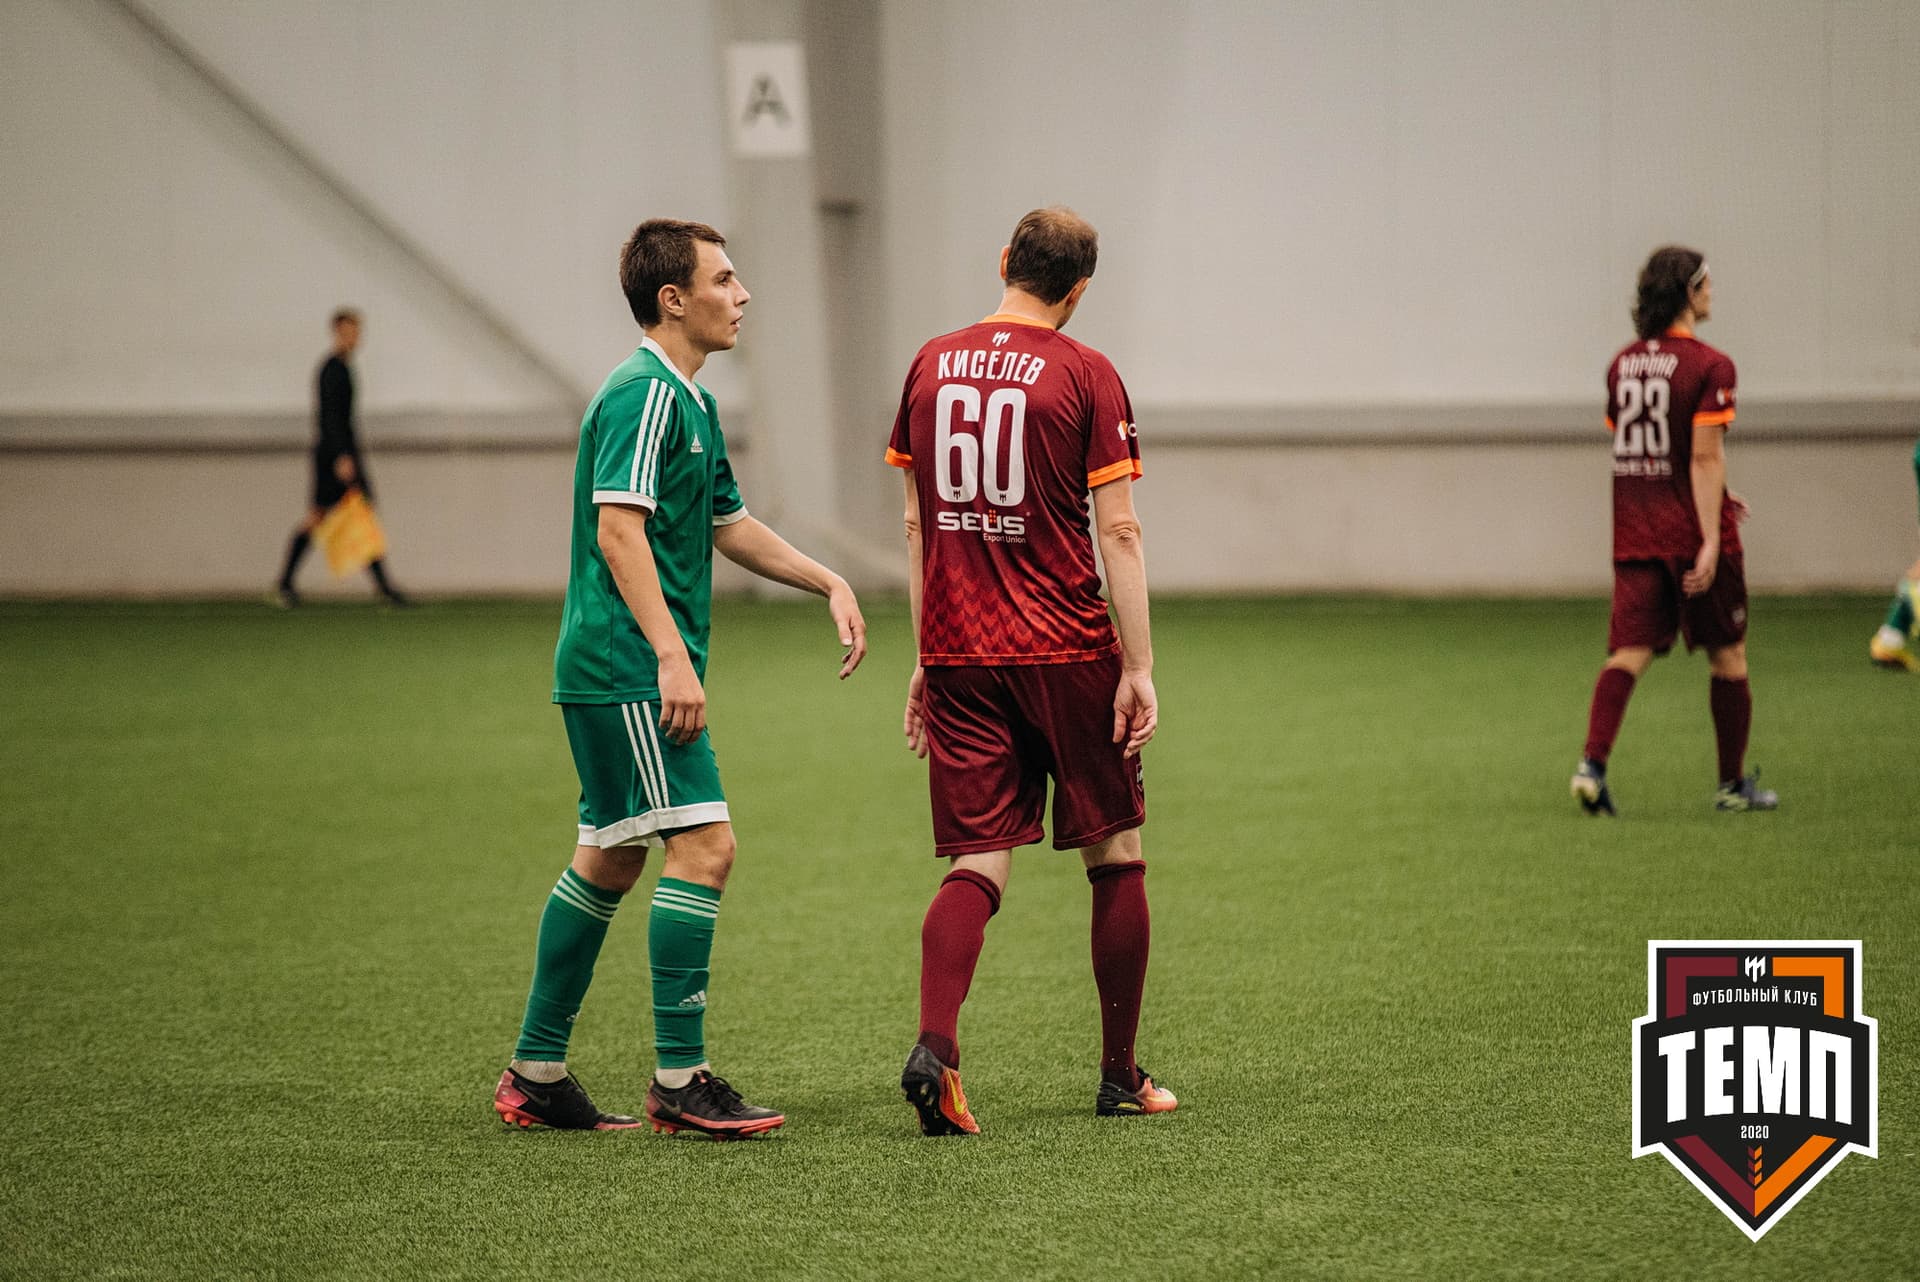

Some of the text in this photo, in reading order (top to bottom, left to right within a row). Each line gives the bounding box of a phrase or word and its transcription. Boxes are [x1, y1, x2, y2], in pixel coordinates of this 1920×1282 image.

[938, 350, 1046, 385] КИСЕЛЕВ
[935, 384, 1027, 507] 60
[1615, 378, 1671, 457] 23
[1005, 535, 1026, 544] Union
